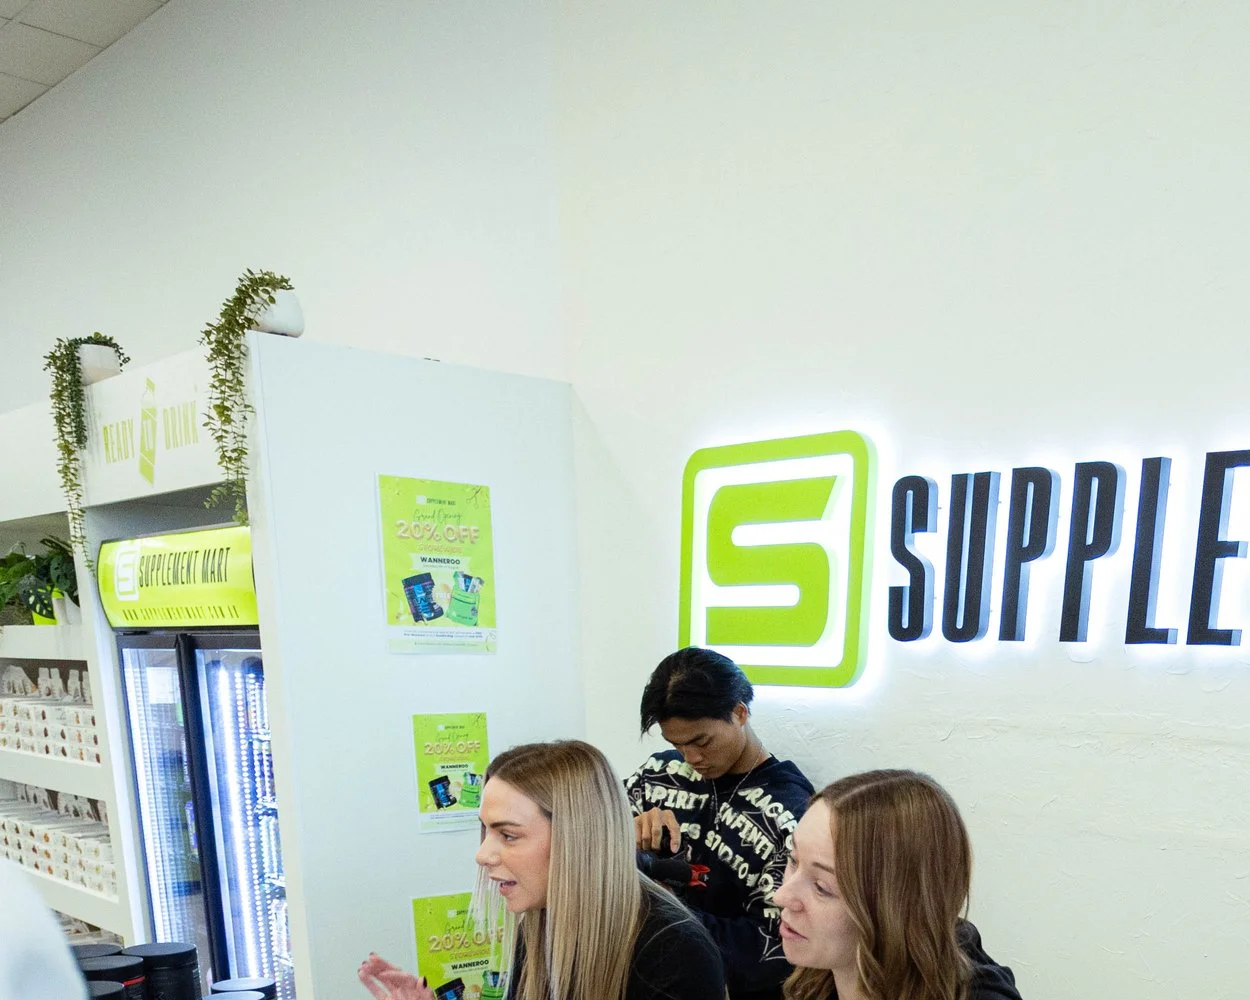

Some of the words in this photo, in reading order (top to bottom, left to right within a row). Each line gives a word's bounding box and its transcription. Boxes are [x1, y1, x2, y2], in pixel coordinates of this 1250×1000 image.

[103, 417, 135, 464] READY
[162, 400, 199, 450] DRINK
[395, 519, 442, 542] 20%
[443, 524, 480, 545] OFF
[138, 549, 200, 588] SUPPLEMENT
[201, 547, 231, 584] MART
[419, 556, 461, 566] WANNEROO
[424, 742, 454, 756] 20%
[456, 740, 481, 755] OFF
[429, 931, 471, 953] 20%
[451, 959, 490, 970] WANNEROO
